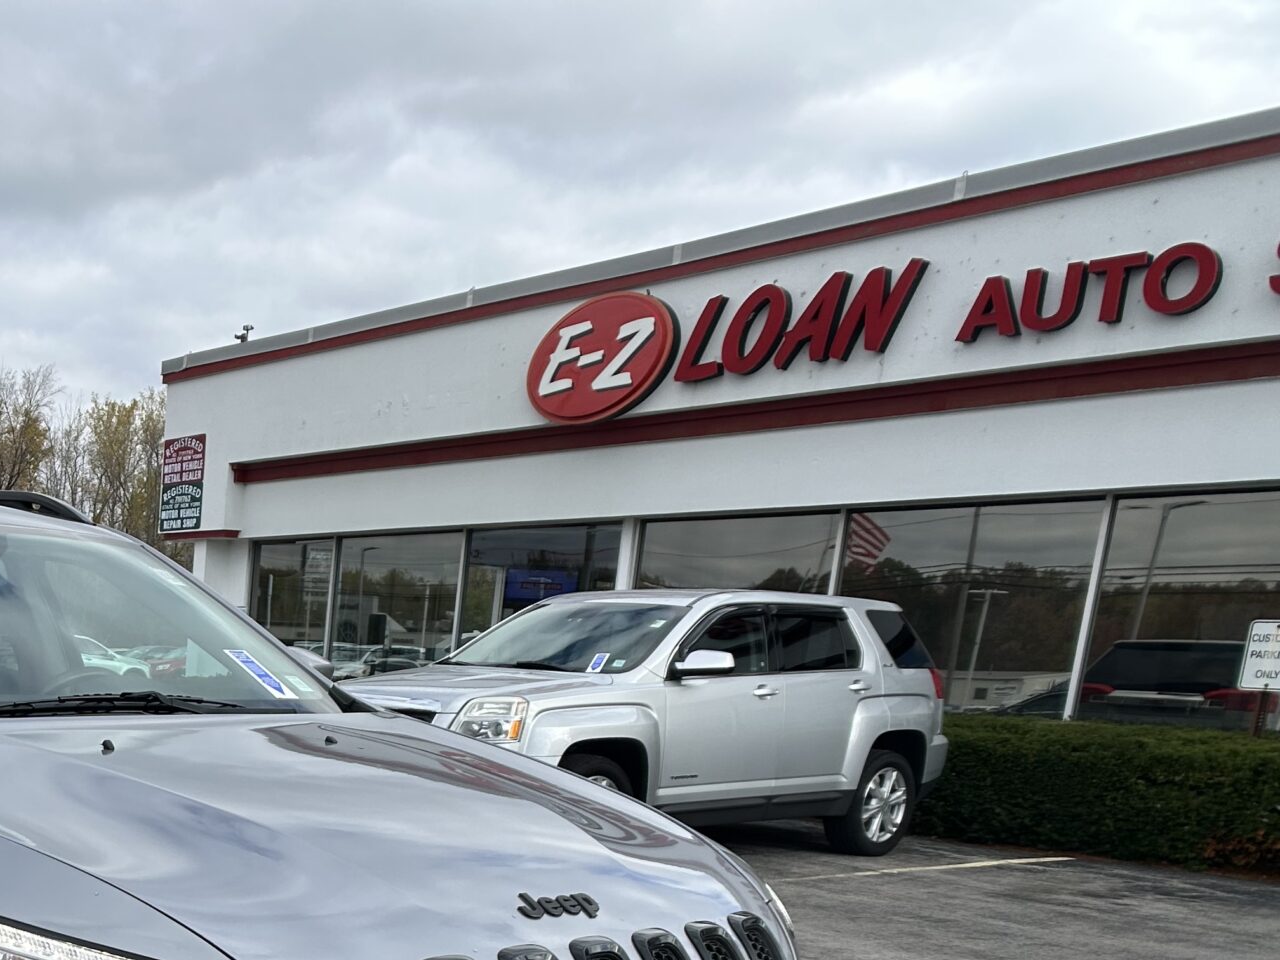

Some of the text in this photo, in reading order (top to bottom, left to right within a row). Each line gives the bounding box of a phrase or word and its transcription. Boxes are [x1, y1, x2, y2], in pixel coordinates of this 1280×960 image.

[537, 315, 656, 397] E-Z
[673, 257, 930, 383] LOAN
[954, 242, 1224, 344] AUTO
[165, 437, 204, 457] REGISTERED
[164, 459, 203, 474] MOTOR VEHICLE
[164, 470, 202, 483] RETAIL DEALER
[163, 484, 202, 502] REGISTERED
[161, 507, 200, 519] MOTOR VEHICLE
[163, 518, 197, 529] REPAIR SHOP
[1255, 670, 1280, 679] ONLY
[517, 892, 600, 920] Jeep
